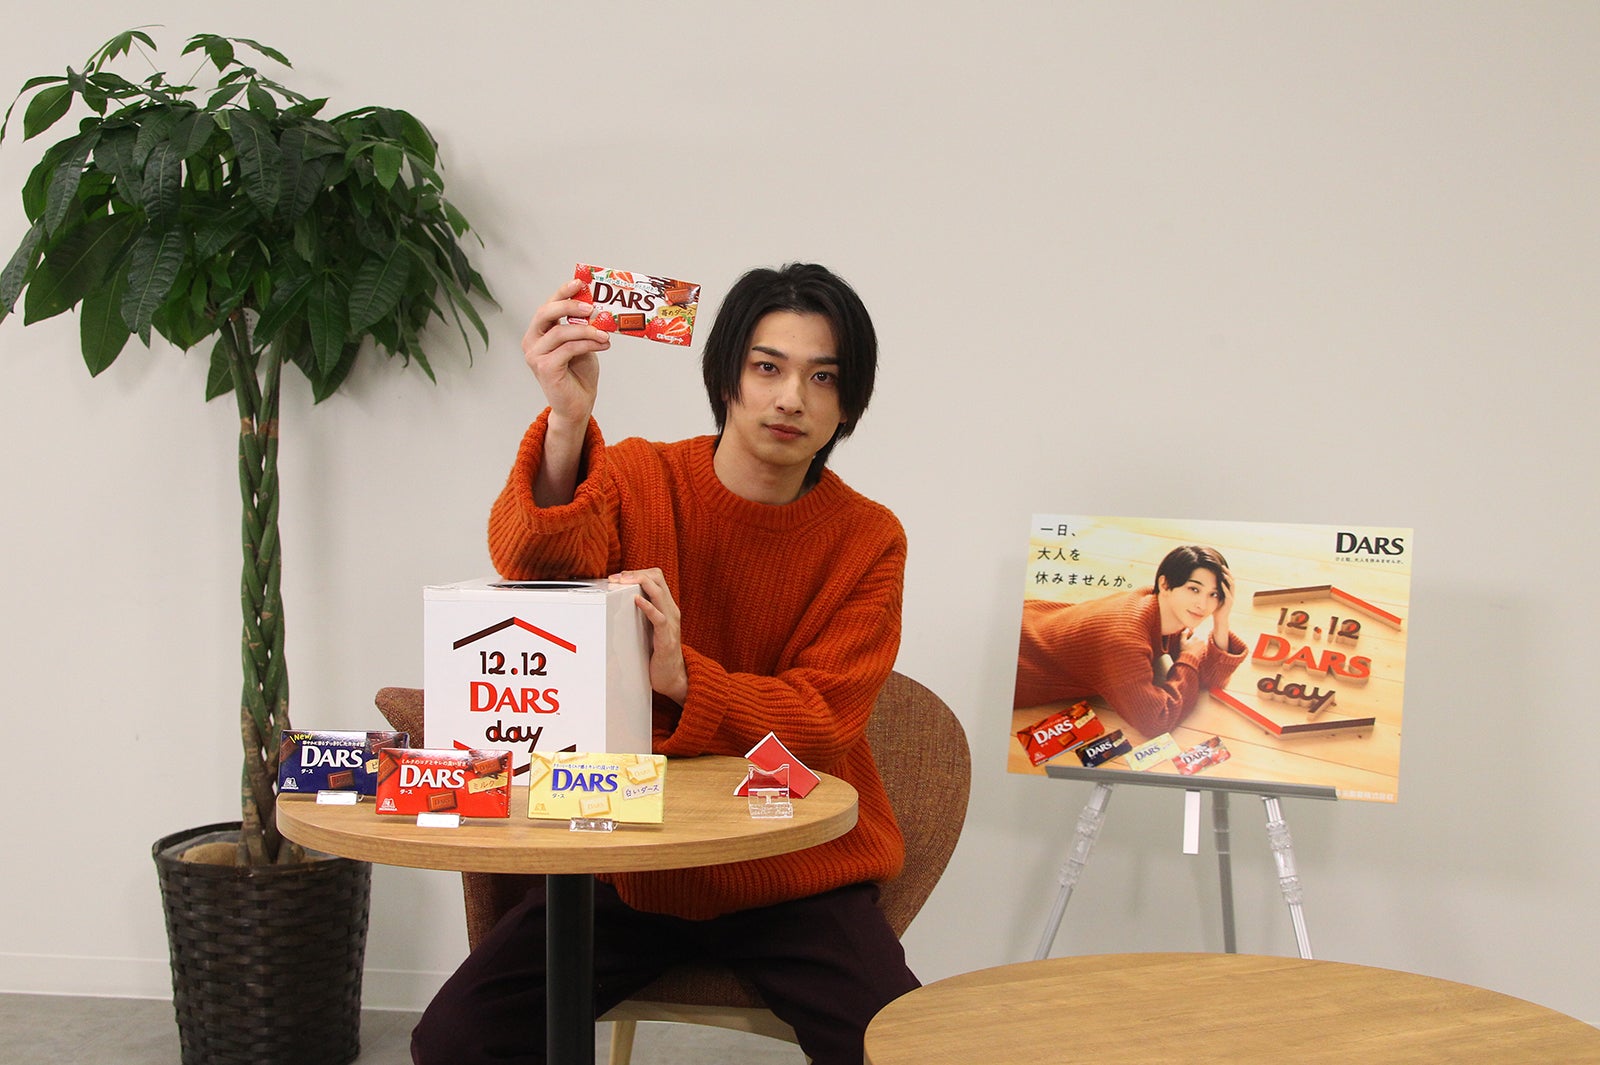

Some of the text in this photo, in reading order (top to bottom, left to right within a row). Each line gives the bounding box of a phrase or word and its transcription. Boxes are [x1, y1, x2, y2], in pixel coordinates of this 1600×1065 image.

[592, 281, 656, 311] DARS
[1040, 524, 1076, 536] 一日、
[1037, 547, 1080, 561] 大人を
[1336, 532, 1404, 555] DARS
[1035, 571, 1133, 588] 休みませんか。
[1277, 608, 1361, 640] 12.12
[480, 651, 547, 676] 12.12
[1252, 633, 1372, 679] DARS
[469, 681, 560, 714] DARS
[1257, 674, 1336, 713] day
[485, 720, 543, 753] day
[1033, 720, 1074, 744] DARS
[300, 745, 364, 769] DARS
[1086, 741, 1113, 758] DARS
[1134, 745, 1161, 761] DARS
[1183, 750, 1211, 764] DARS
[399, 764, 466, 789] DARS
[474, 779, 495, 789] ミルク
[551, 768, 619, 793] DARS
[625, 785, 660, 797] 白いダース
